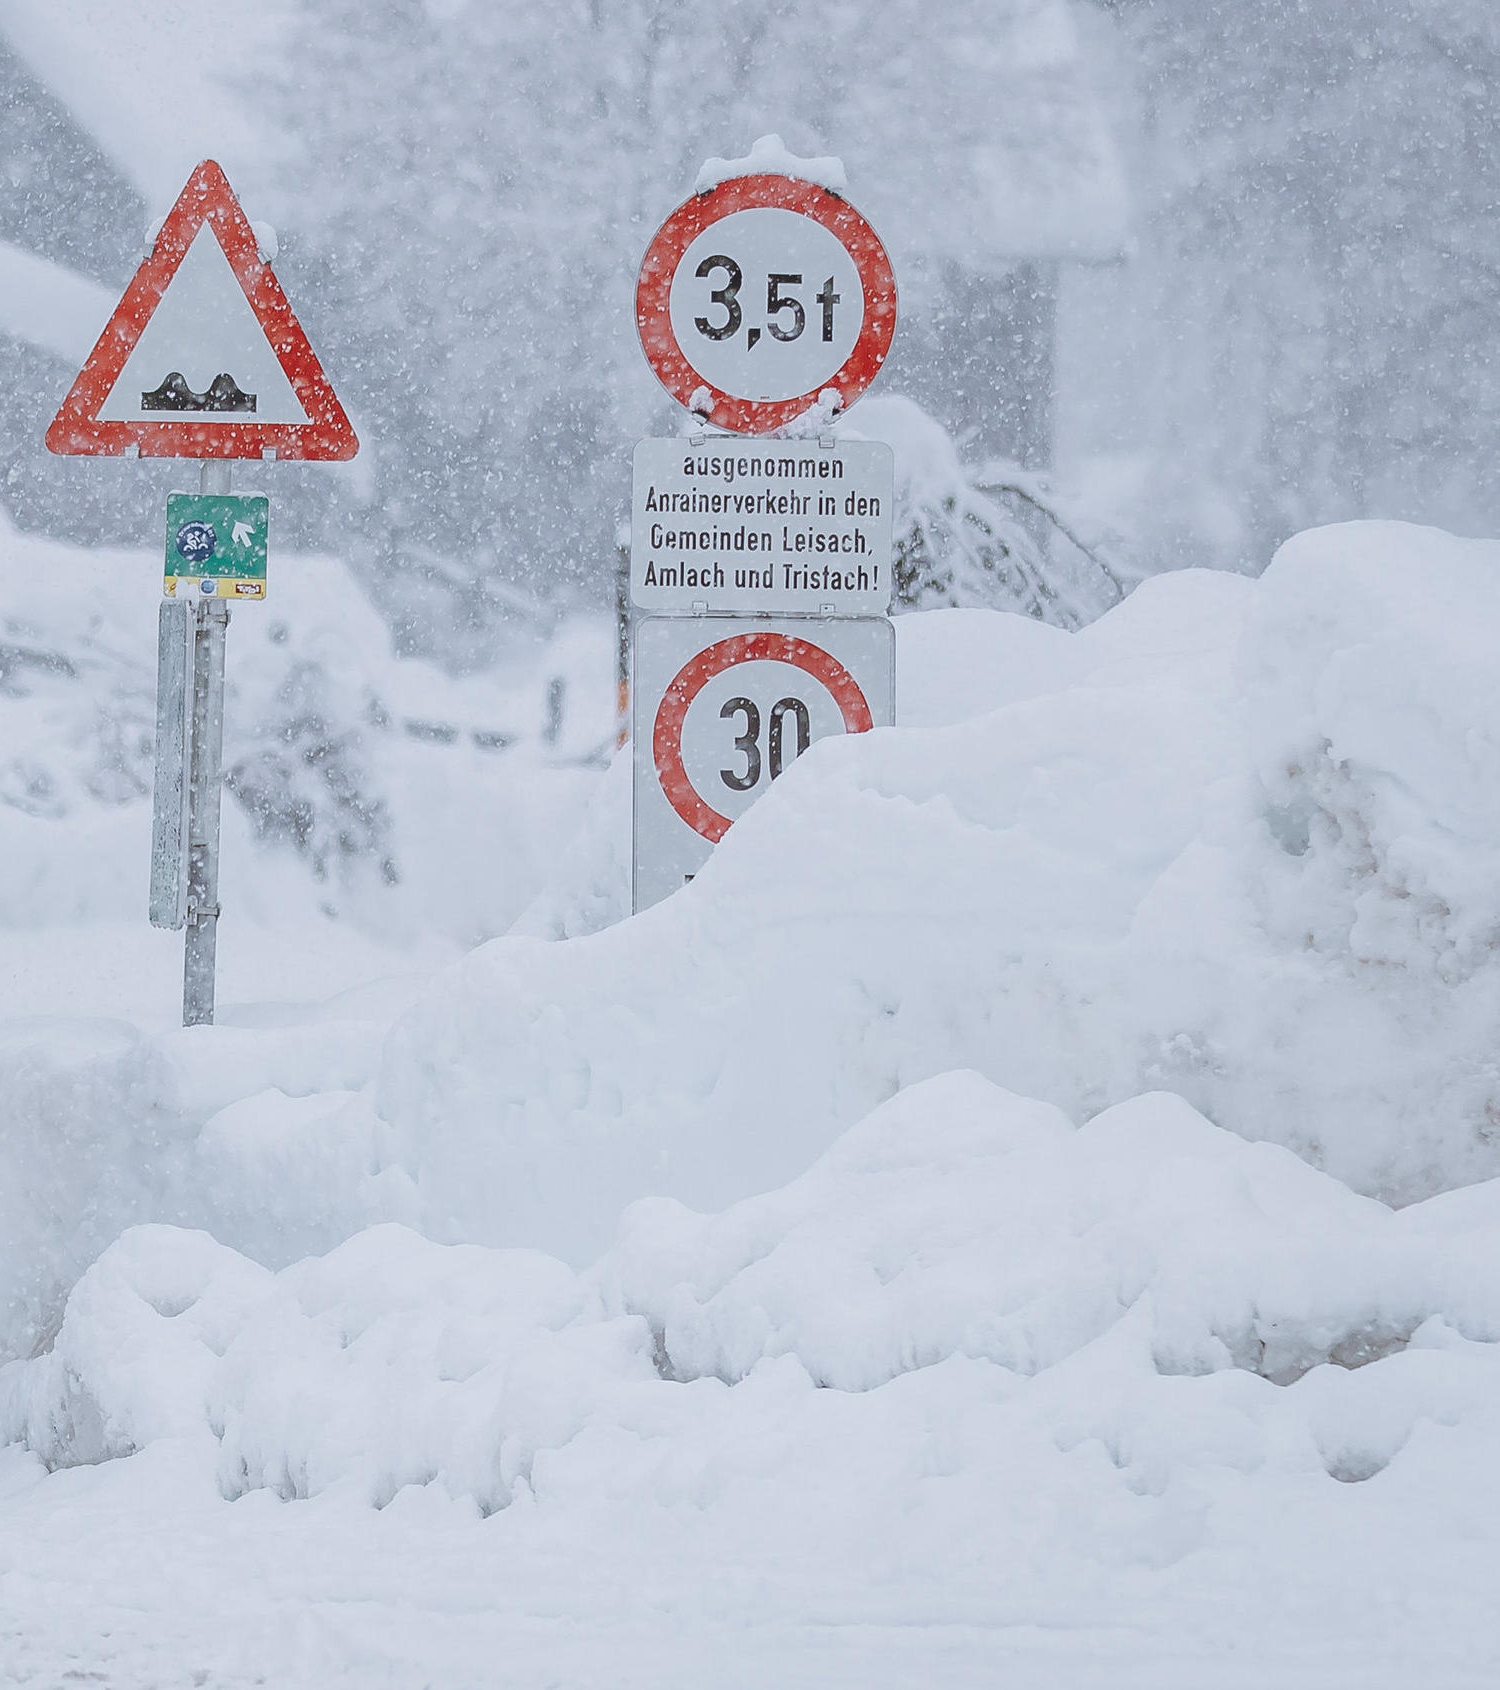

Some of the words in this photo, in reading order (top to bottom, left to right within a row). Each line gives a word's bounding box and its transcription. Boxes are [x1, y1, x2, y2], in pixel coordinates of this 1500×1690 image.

[683, 456, 843, 483] ausgenommen
[645, 486, 811, 514] Anrainerverkehr
[818, 490, 836, 516] in
[844, 491, 880, 517] den
[650, 523, 772, 552] Gemeinden
[782, 526, 873, 557] Leisach,
[644, 561, 724, 588] Amlach
[734, 563, 773, 589] und
[782, 563, 879, 592] Tristach!
[719, 696, 811, 791] 30
